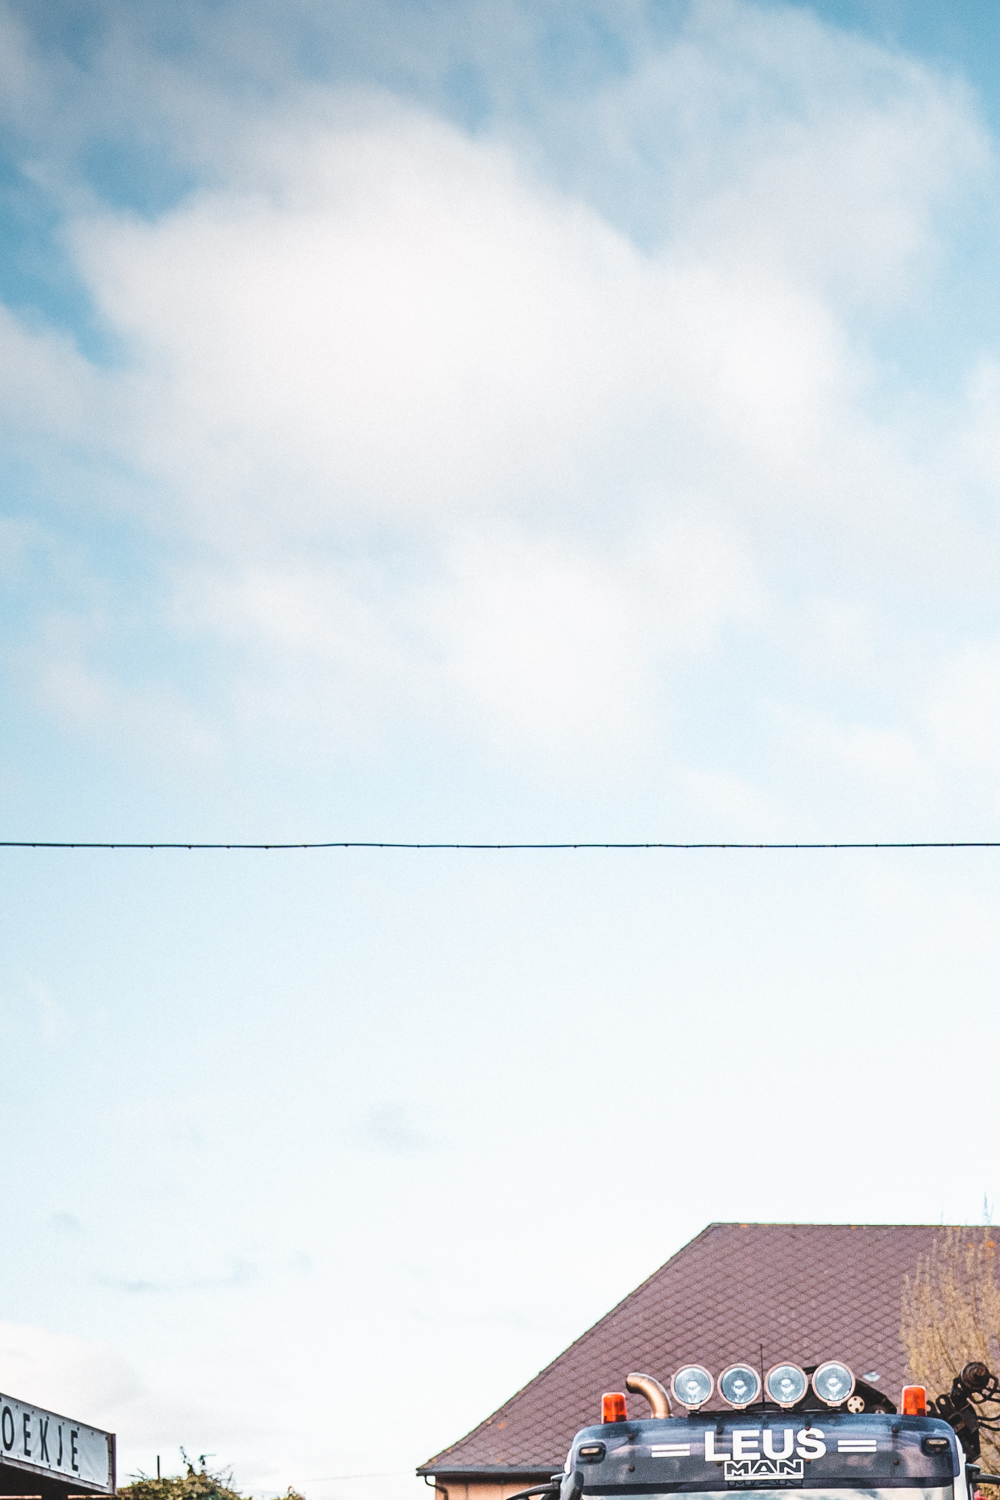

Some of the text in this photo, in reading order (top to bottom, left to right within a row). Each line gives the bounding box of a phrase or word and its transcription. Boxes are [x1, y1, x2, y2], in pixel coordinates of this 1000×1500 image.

[2, 1406, 79, 1472] OEKJE
[704, 1427, 827, 1461] LEUS
[724, 1459, 804, 1478] MAN
